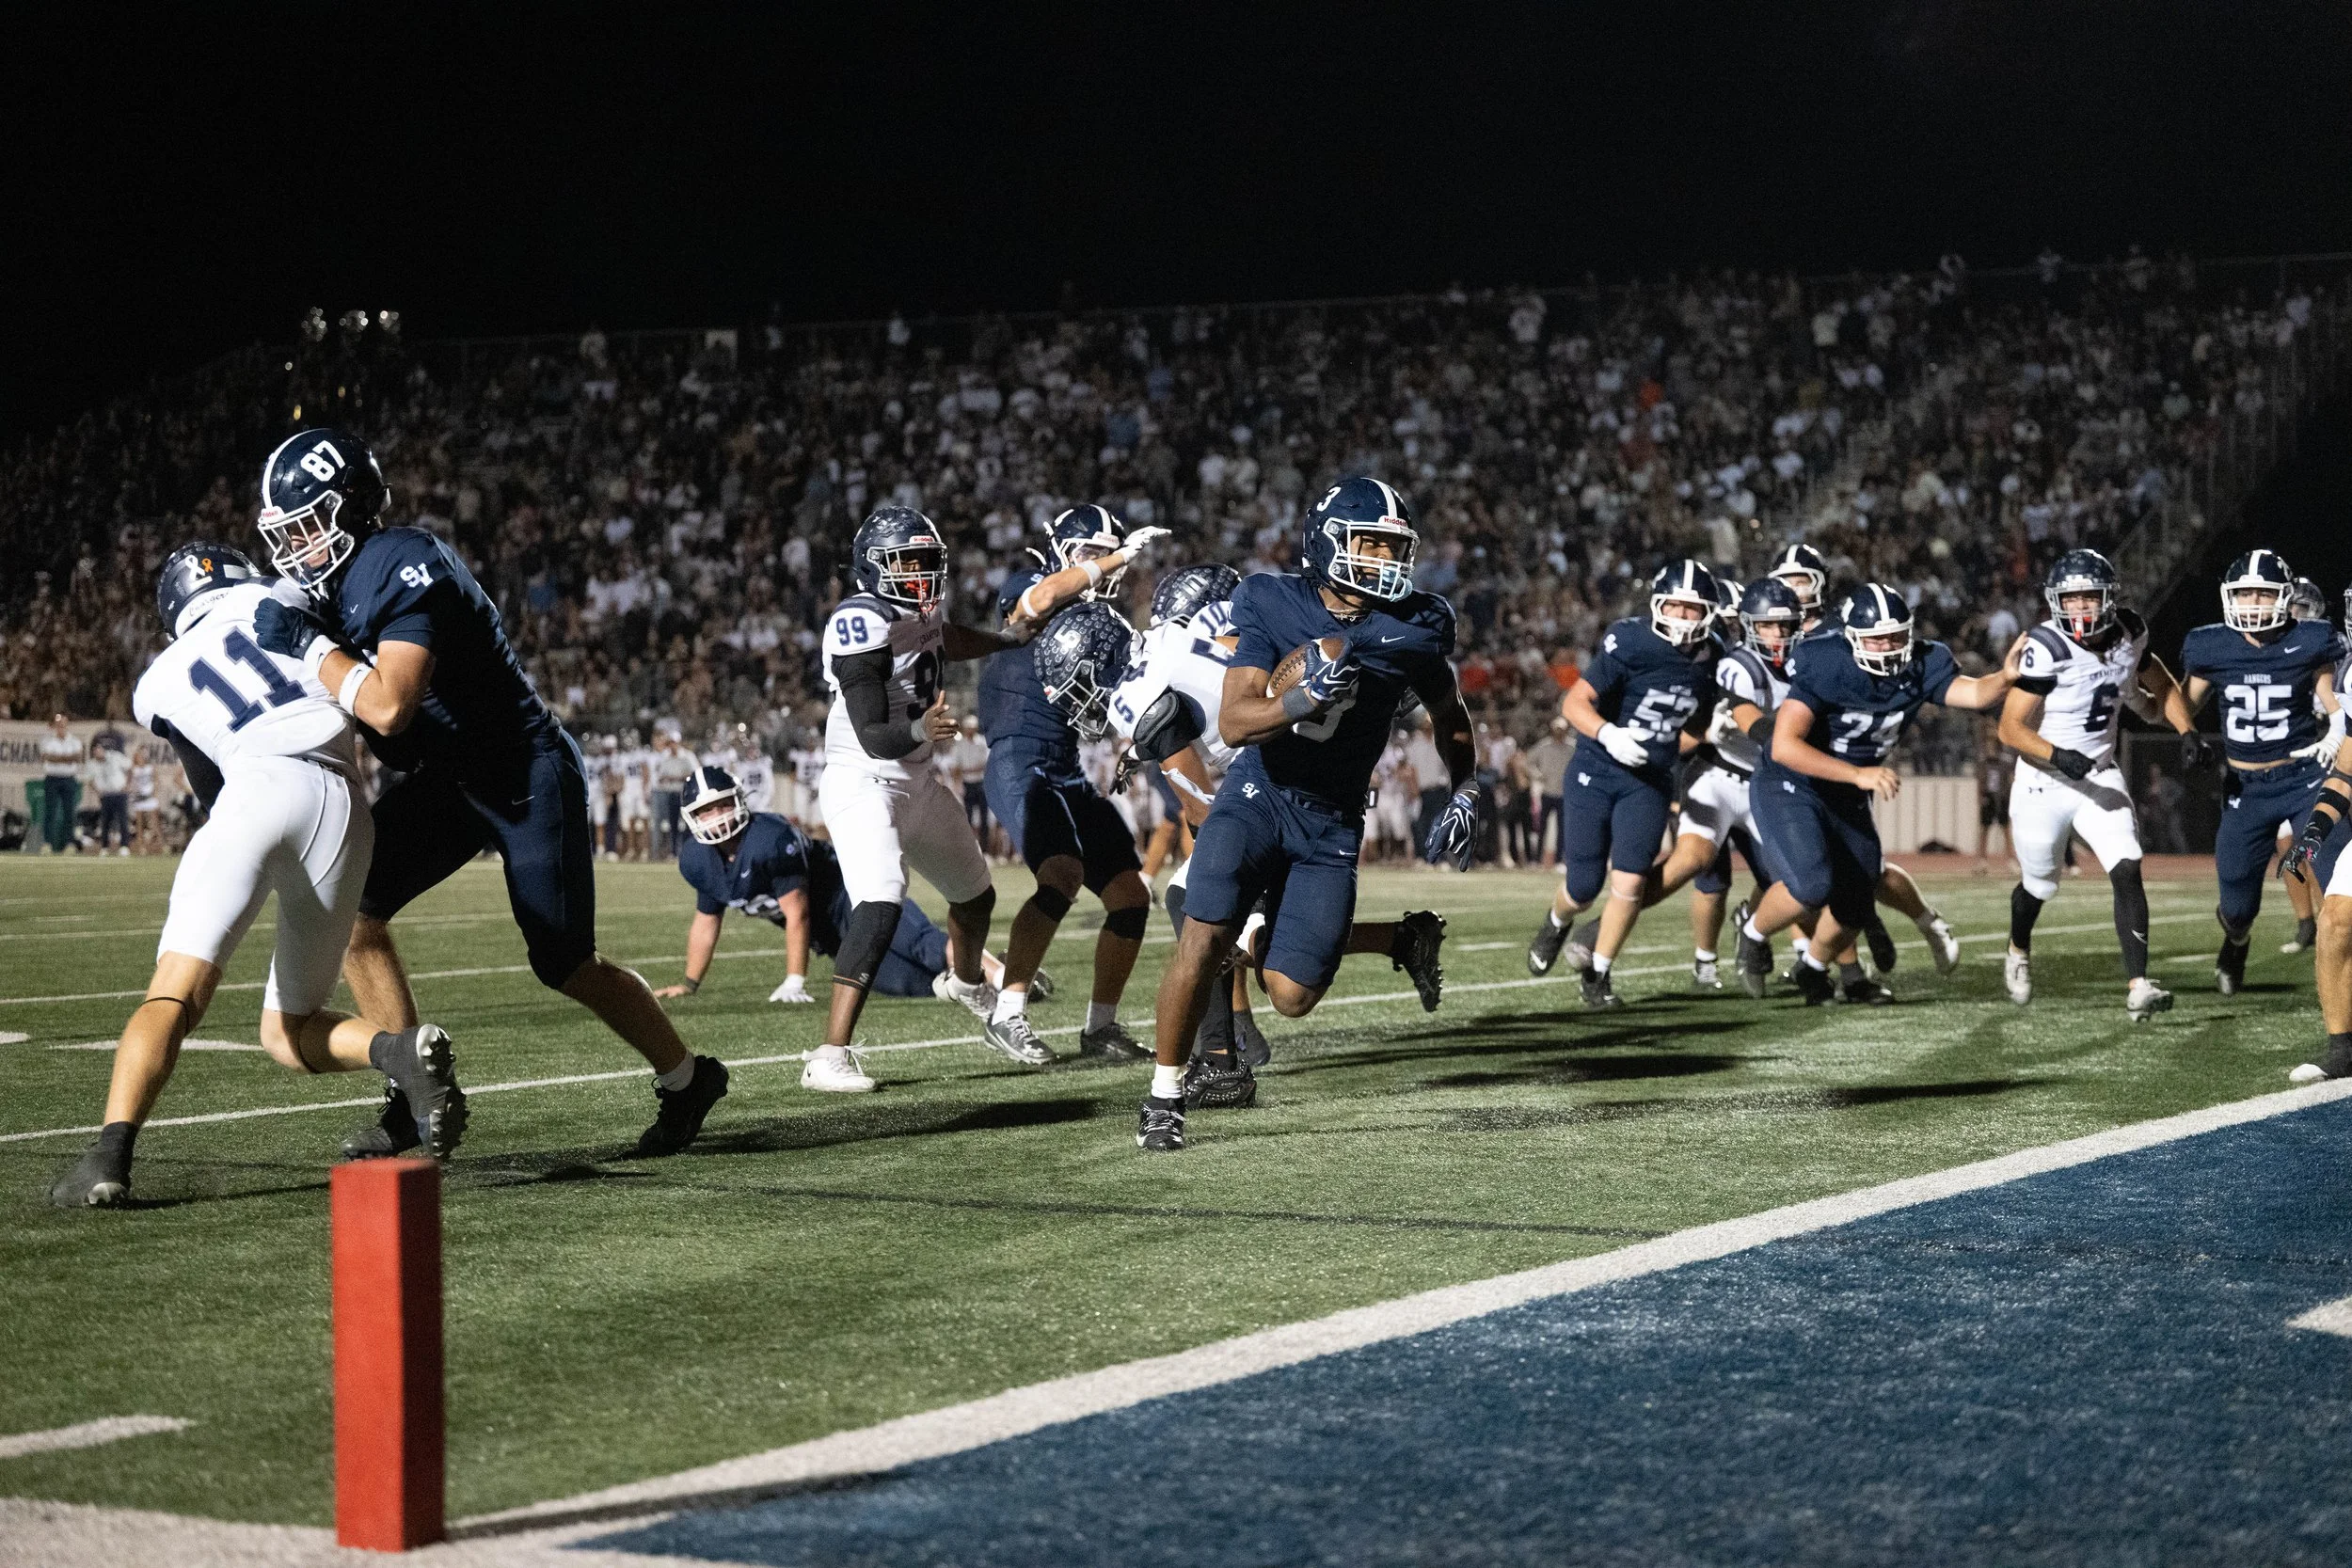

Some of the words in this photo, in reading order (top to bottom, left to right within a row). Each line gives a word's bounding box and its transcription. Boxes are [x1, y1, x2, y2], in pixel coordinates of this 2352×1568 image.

[300, 440, 345, 482] 87
[1317, 486, 1342, 512] 3
[400, 562, 434, 588] SV
[836, 616, 868, 646] 99
[1199, 601, 1227, 638] 10
[1054, 624, 1081, 649] 5
[187, 626, 308, 734] 11
[1114, 695, 1136, 724] 5
[2084, 682, 2120, 733] 6
[2224, 684, 2292, 743] 25
[1829, 711, 1905, 758] 74
[1242, 783, 1261, 799] SV
